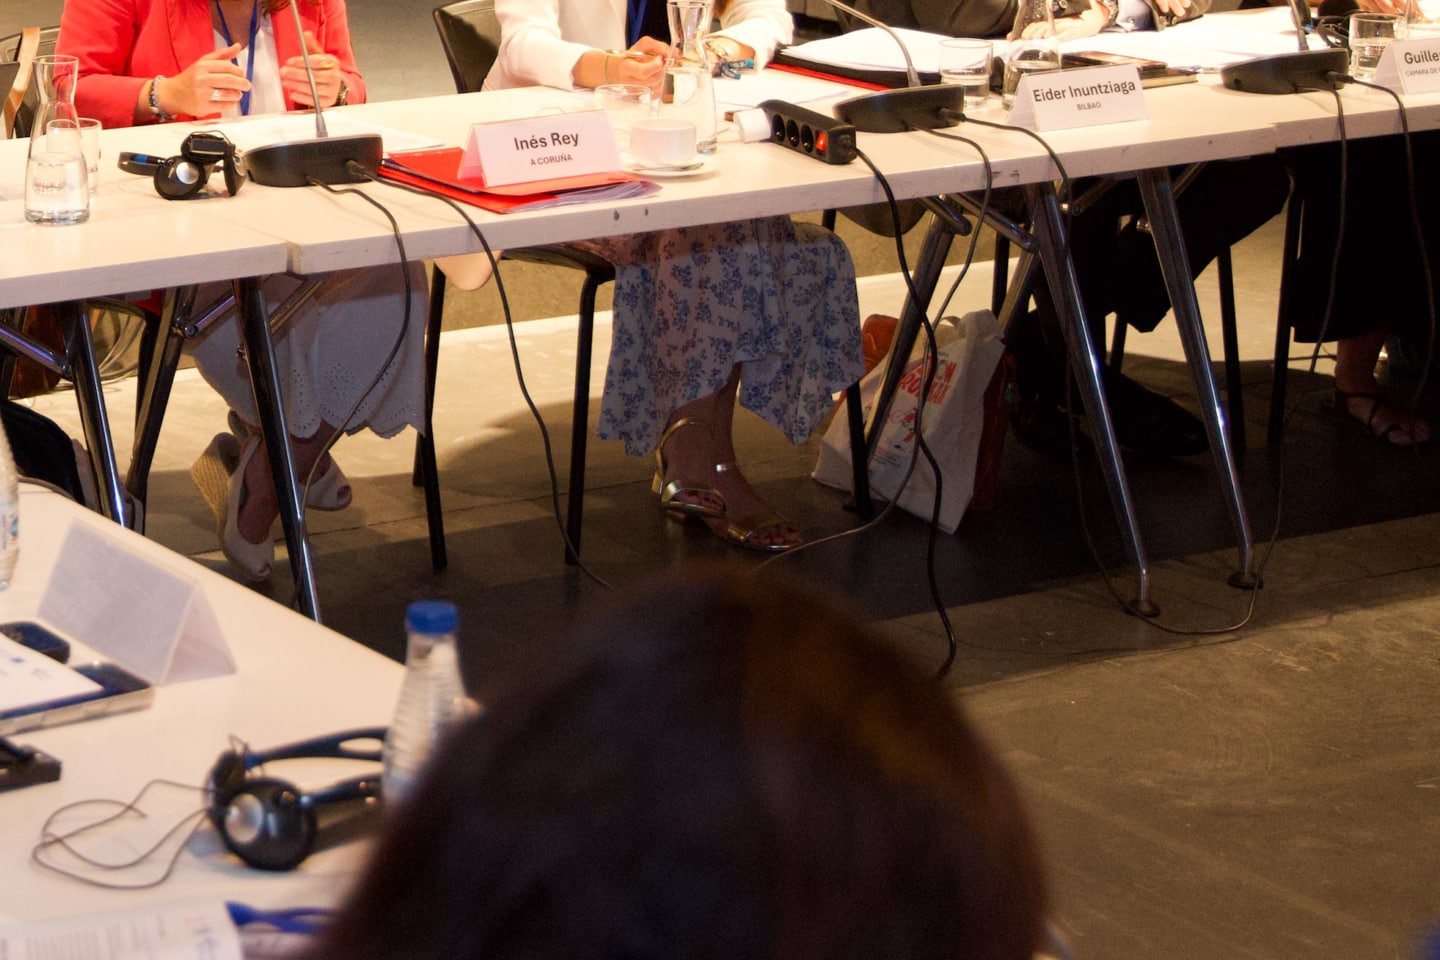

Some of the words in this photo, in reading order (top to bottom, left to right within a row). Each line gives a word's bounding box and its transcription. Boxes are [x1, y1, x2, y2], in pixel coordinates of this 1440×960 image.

[1033, 87, 1066, 102] Eider
[1068, 80, 1136, 98] Inuntziaga
[1076, 101, 1102, 111] BILBAO
[514, 134, 548, 151] Inés
[551, 132, 579, 147] Rey
[530, 157, 537, 166] A
[537, 153, 573, 166] CORUÑA
